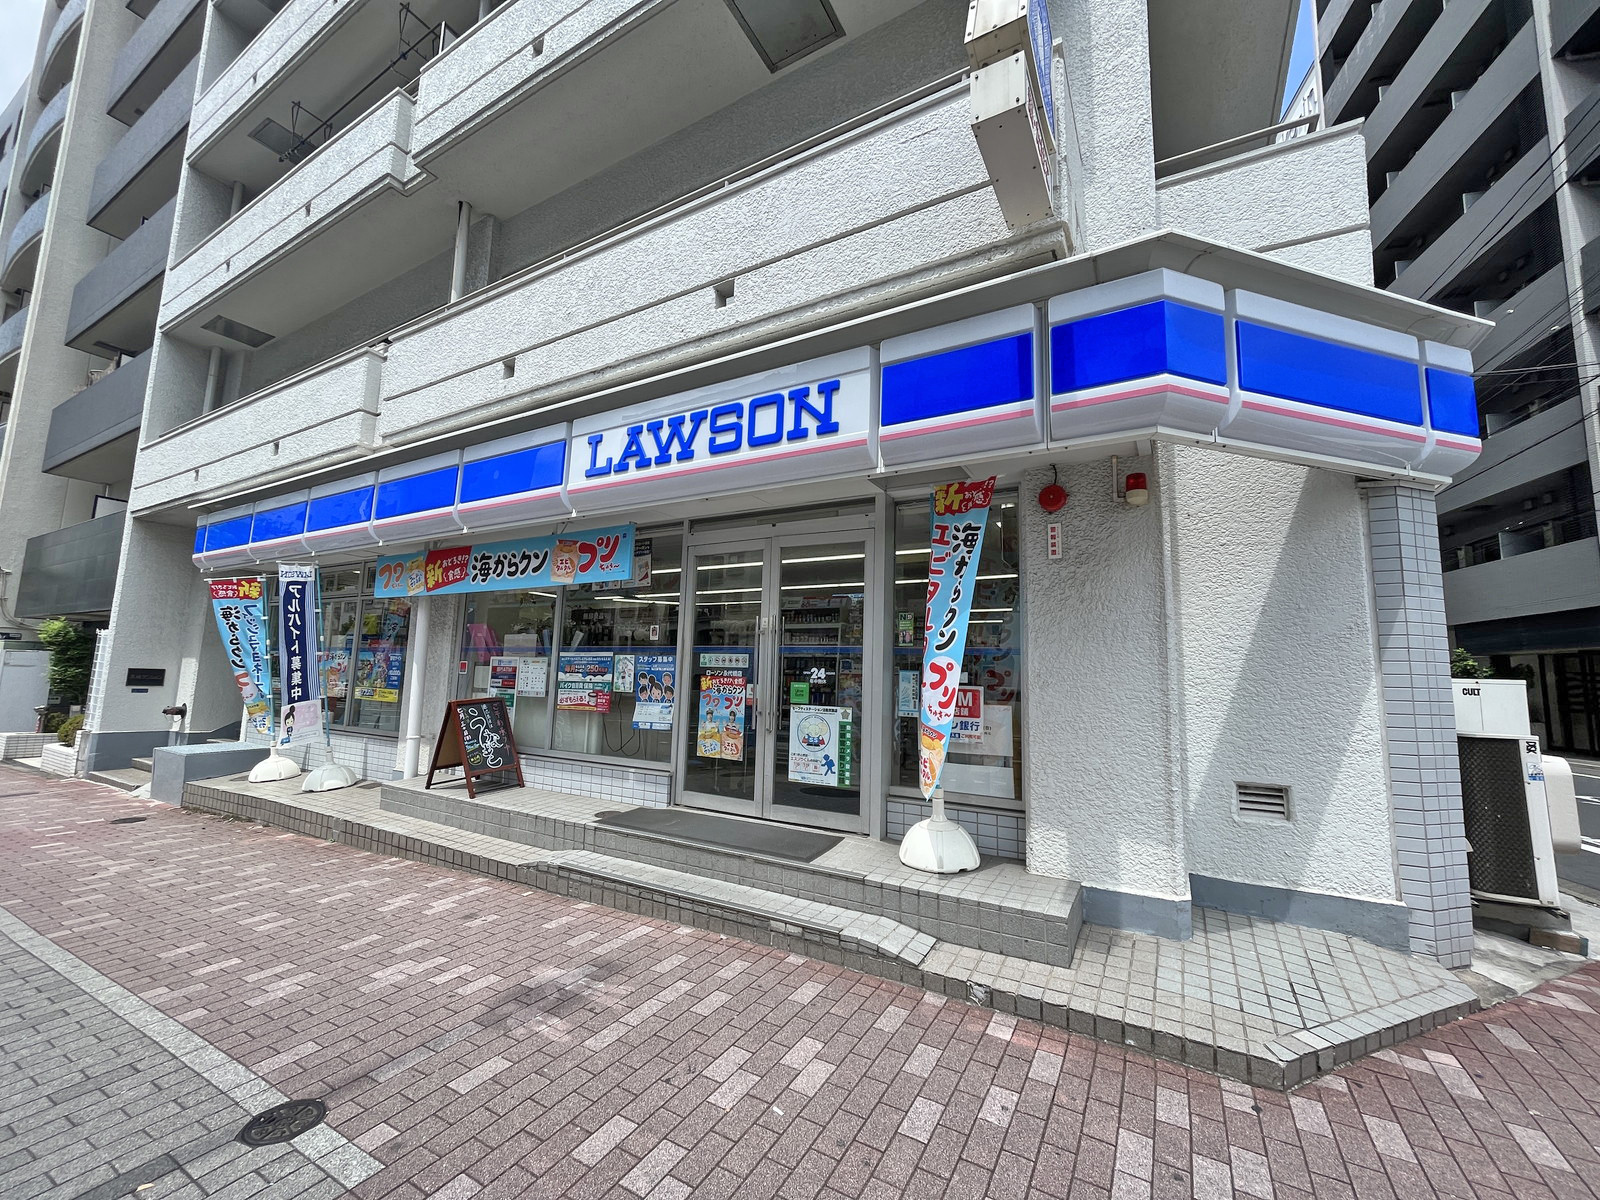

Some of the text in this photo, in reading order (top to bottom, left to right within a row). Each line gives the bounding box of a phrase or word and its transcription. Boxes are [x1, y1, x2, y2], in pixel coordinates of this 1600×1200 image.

[585, 379, 840, 477] LAWSON
[934, 483, 963, 514] 新
[426, 560, 443, 588] 新
[471, 550, 548, 583] 海からクン
[700, 676, 712, 691] 新
[810, 667, 826, 679] 24
[712, 685, 744, 695] 海からクン
[929, 662, 957, 709] プリ
[1462, 688, 1481, 696] CULT
[951, 720, 980, 731] ン銀行
